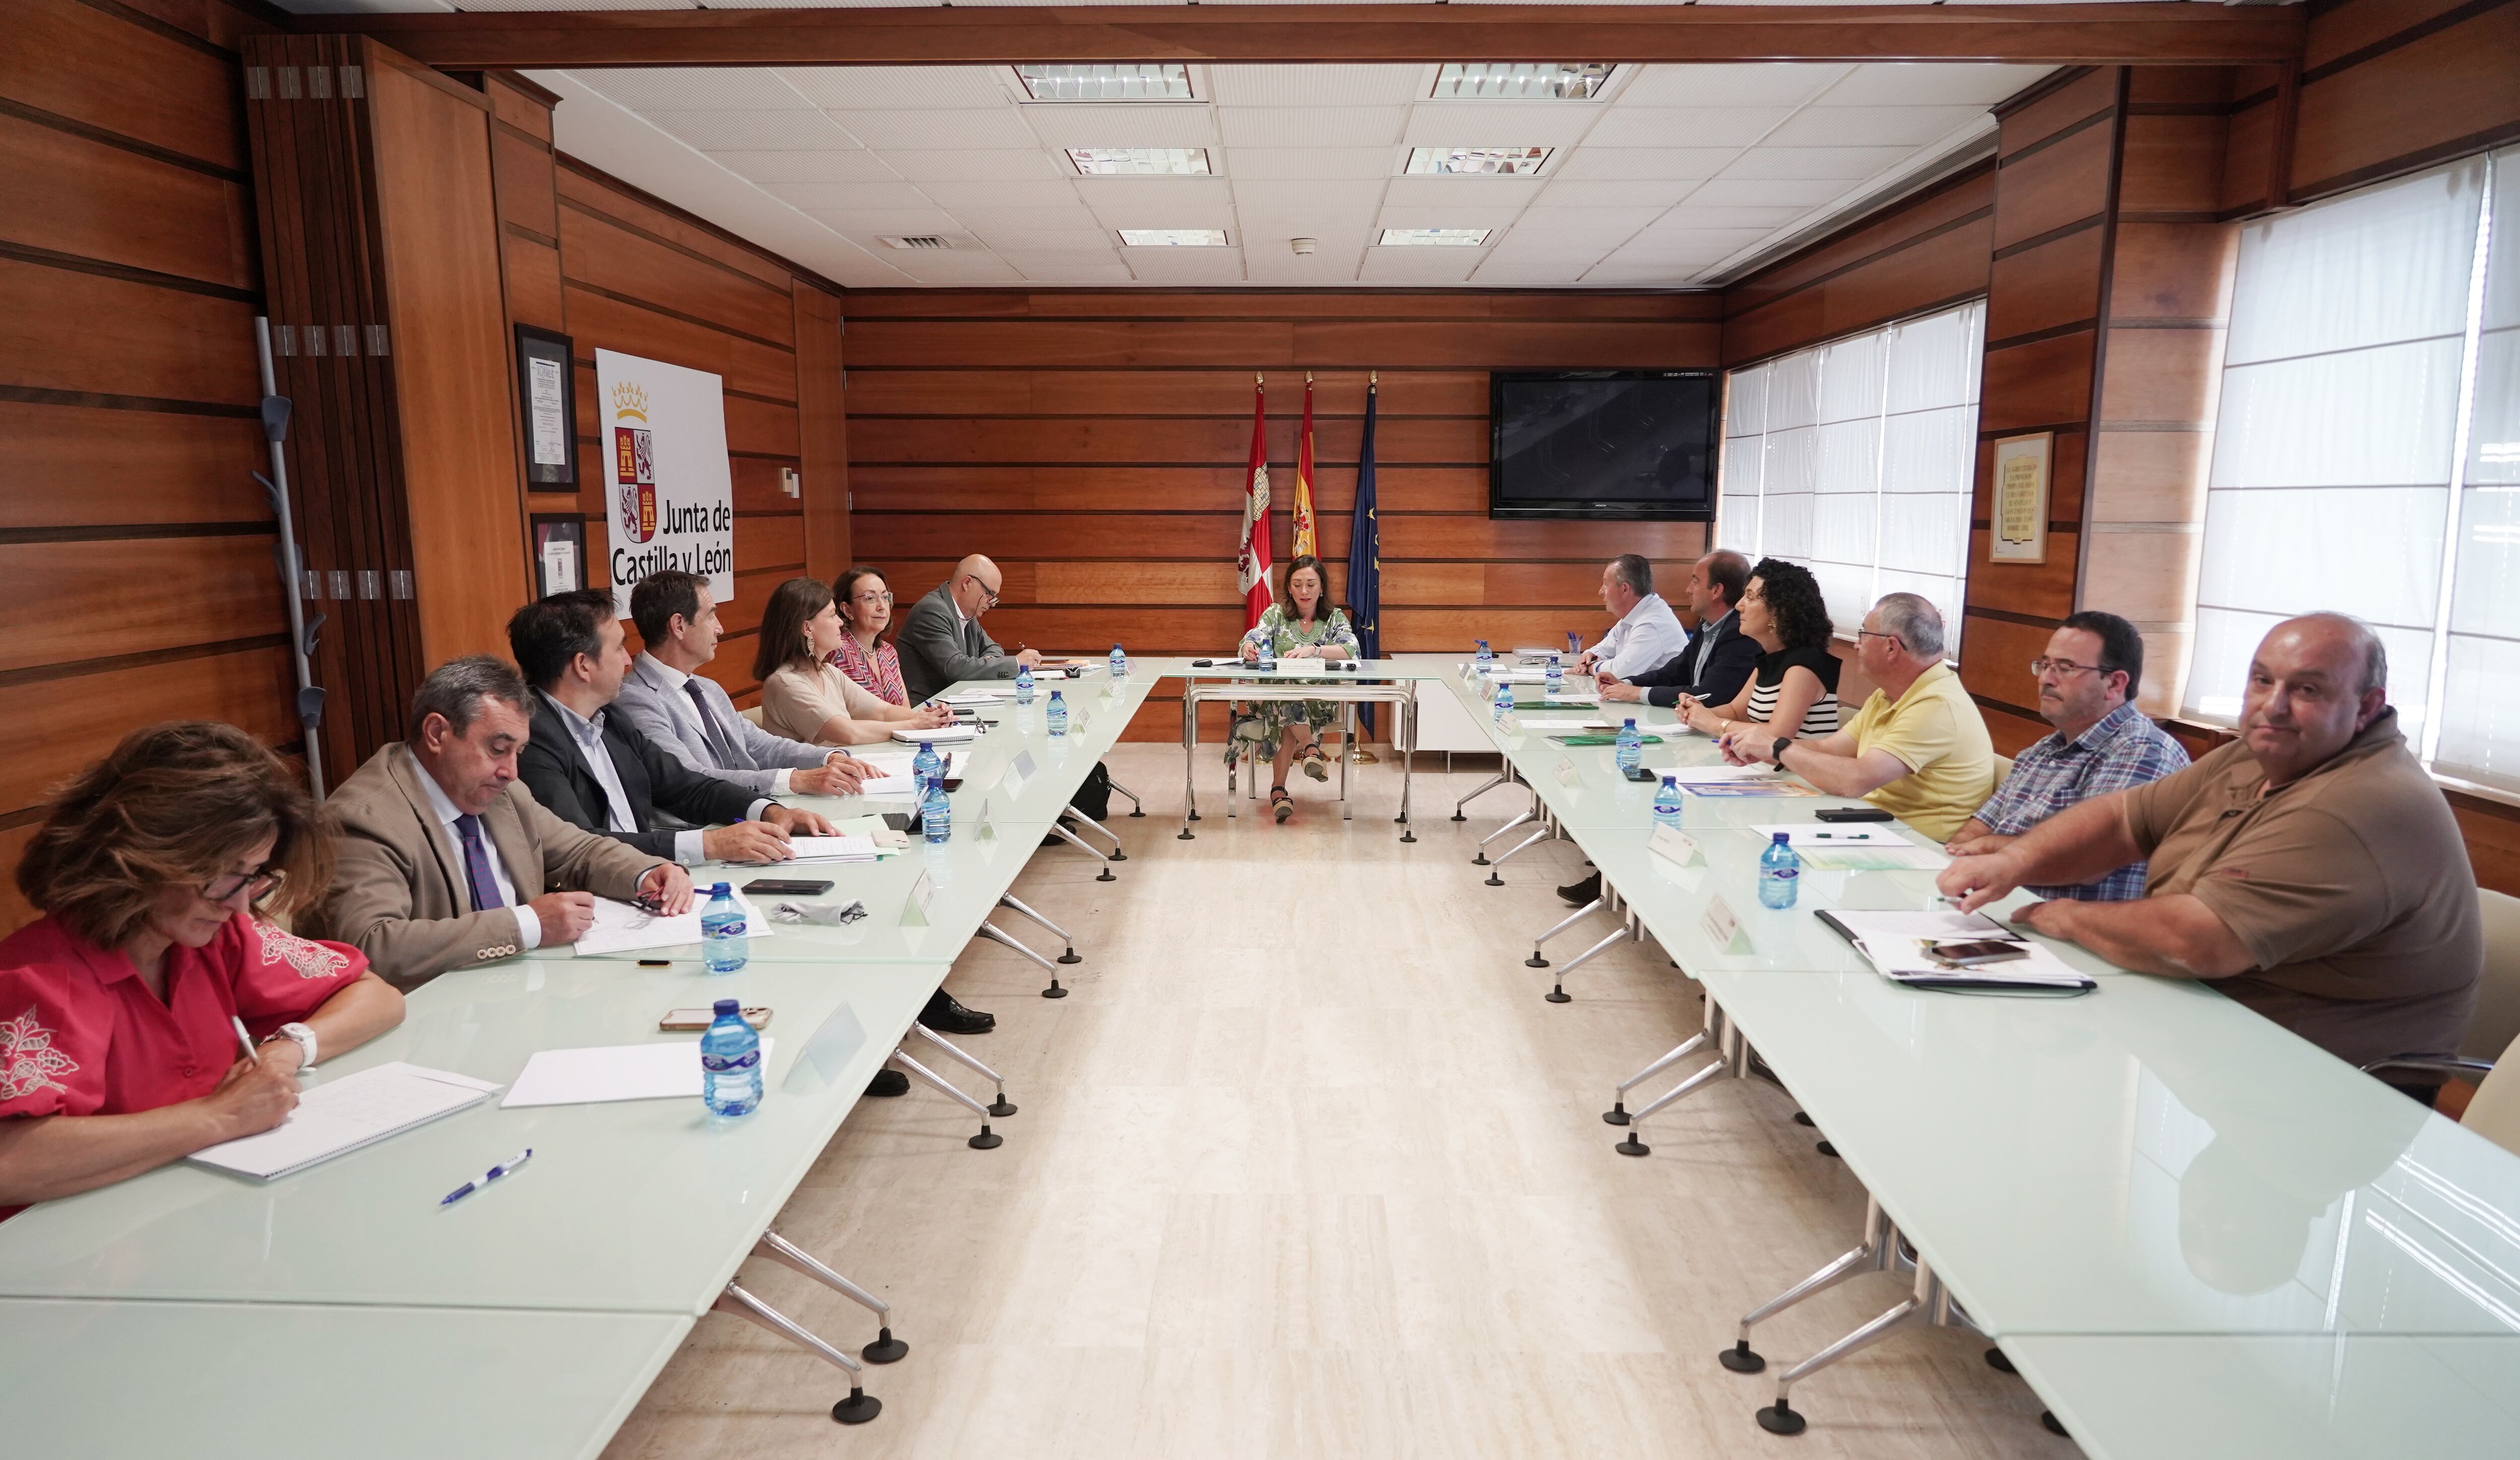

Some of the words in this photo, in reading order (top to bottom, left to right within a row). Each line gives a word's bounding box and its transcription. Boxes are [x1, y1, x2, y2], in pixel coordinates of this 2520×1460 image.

[663, 500, 708, 534] Junta
[713, 500, 730, 531] de
[612, 545, 678, 586] Castilla
[696, 541, 731, 575] León
